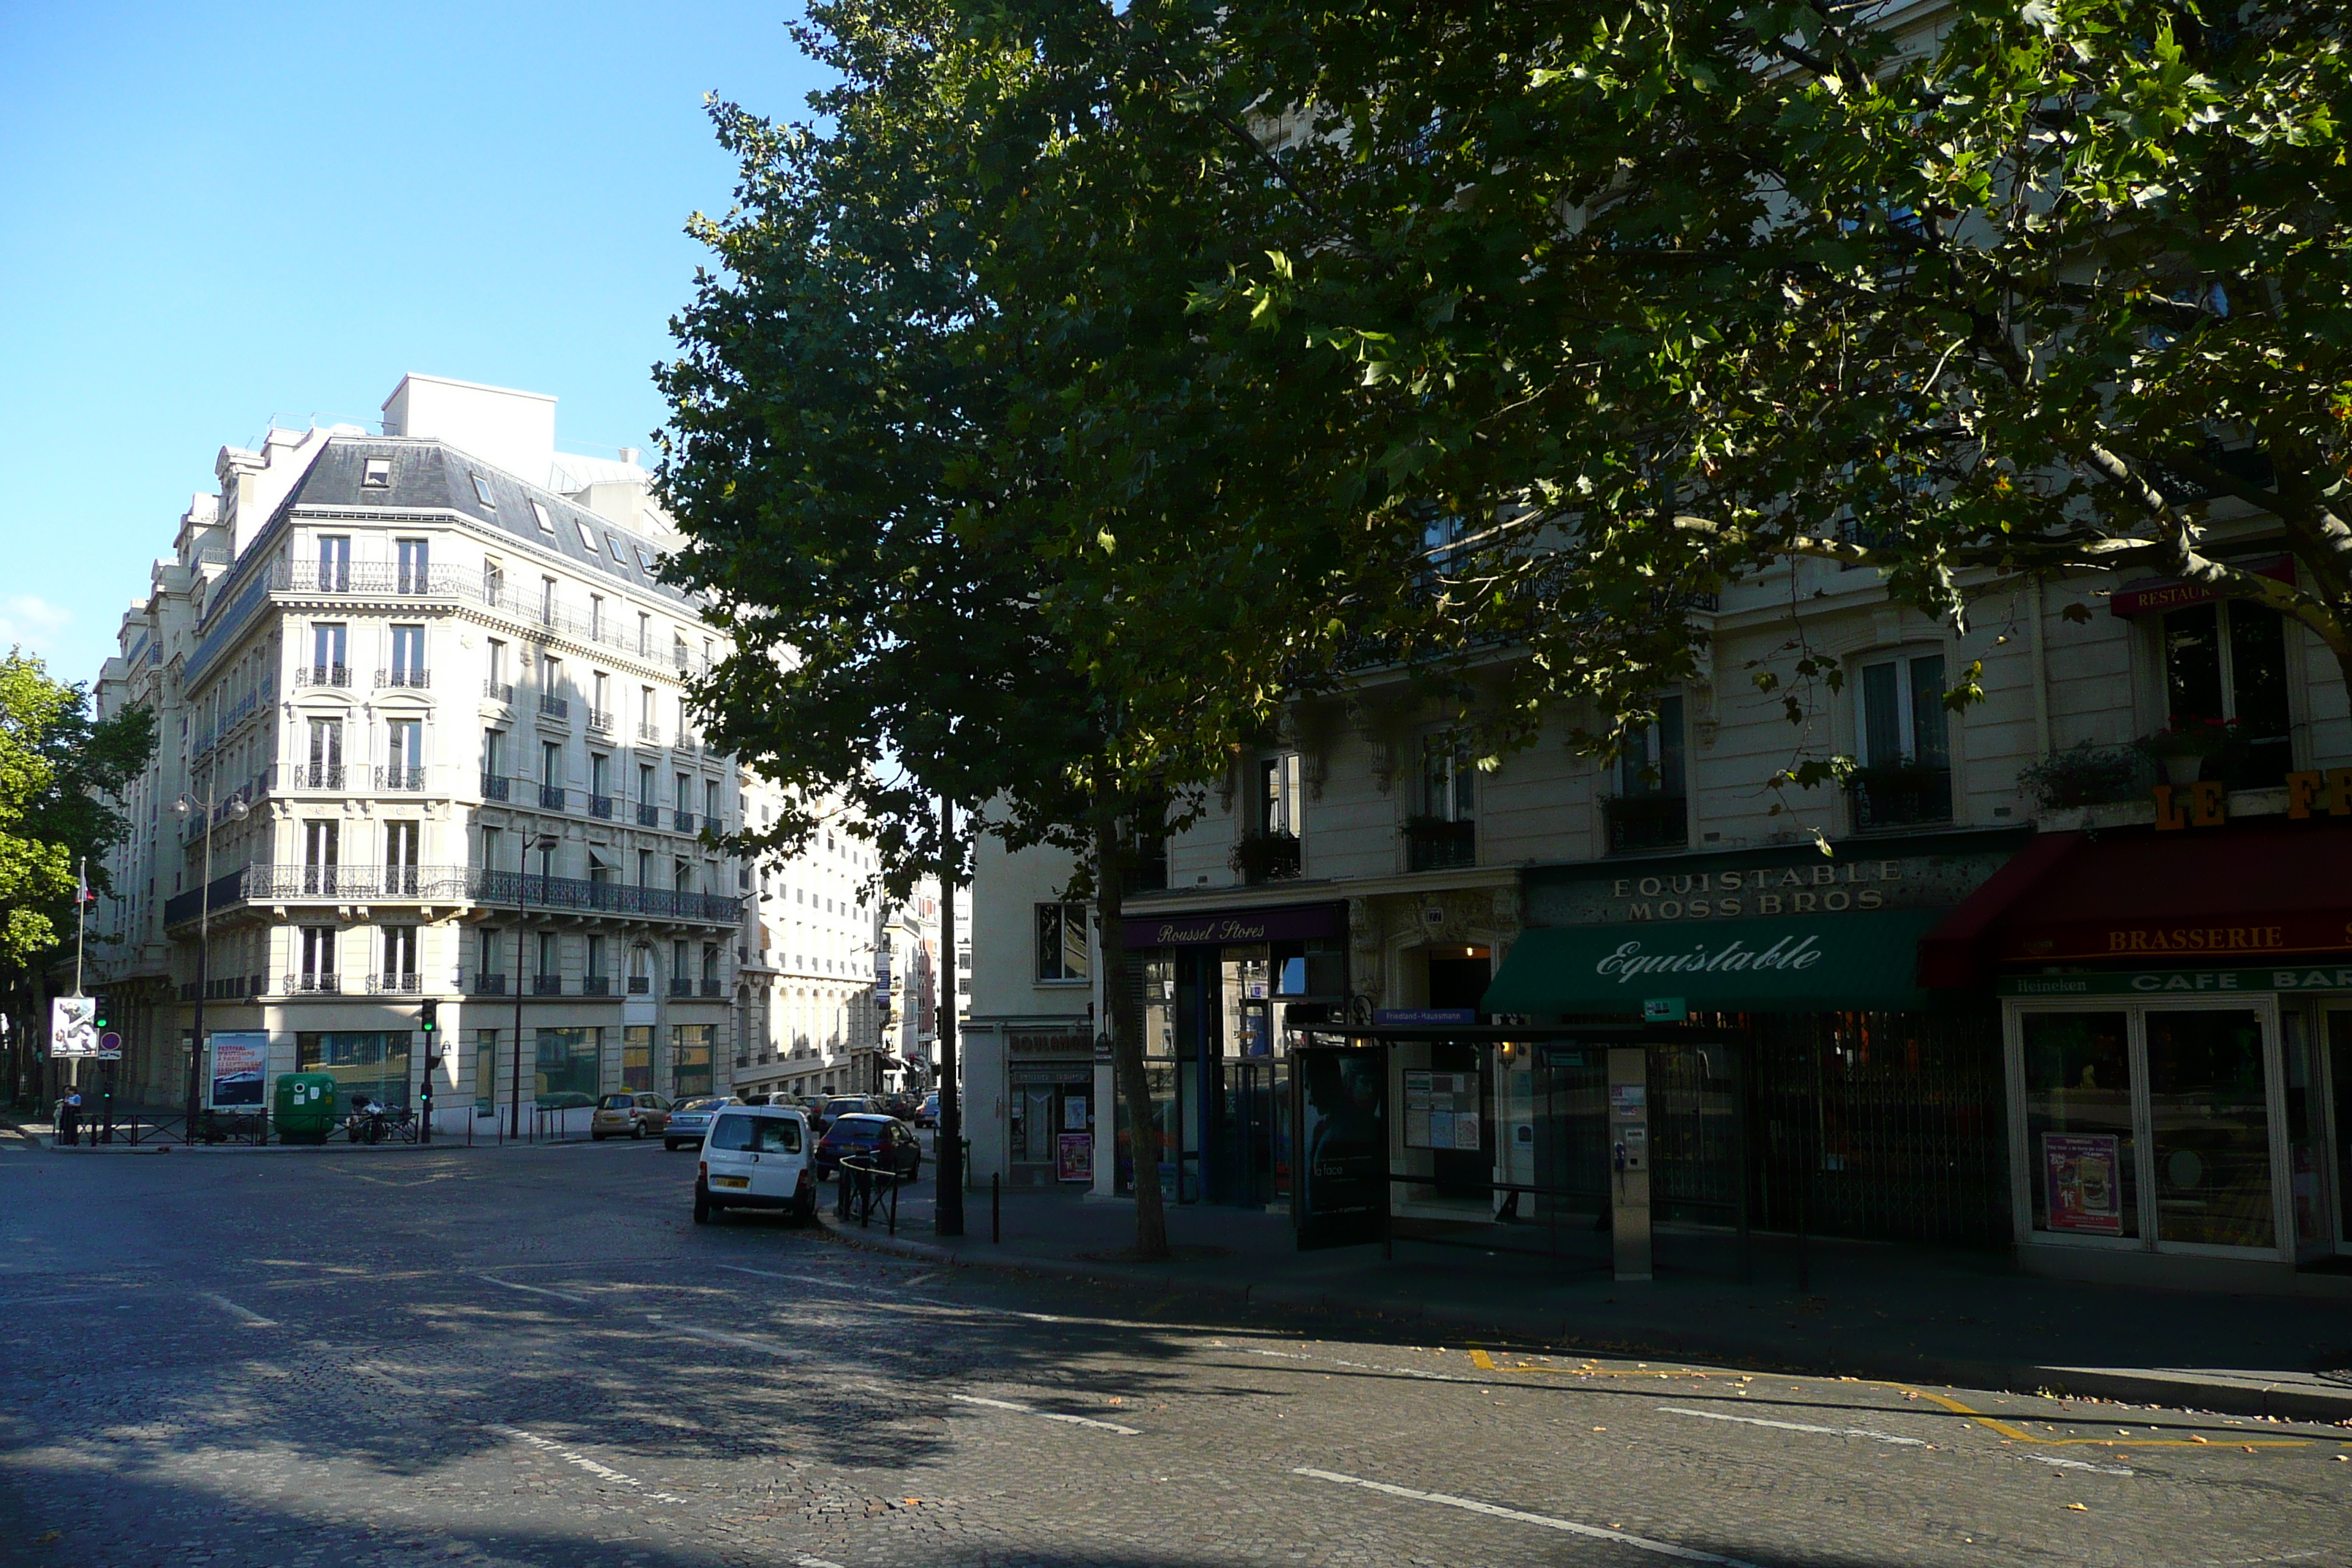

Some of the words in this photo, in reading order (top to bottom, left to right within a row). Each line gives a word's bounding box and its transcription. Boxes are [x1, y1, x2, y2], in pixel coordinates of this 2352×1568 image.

[2138, 587, 2215, 606] RESTAUR
[2152, 780, 2225, 831] LE
[1614, 860, 1902, 897] EQUISTABLE
[1628, 898, 1742, 921] MOSS
[1760, 890, 1883, 914] BROS
[1157, 922, 1215, 943] Roussel
[1219, 920, 1264, 940] Stores
[2108, 927, 2283, 951] BRASSERIE
[1597, 935, 1822, 983] Equistable
[2017, 979, 2087, 992] Heineken
[2131, 973, 2238, 990] CAFE
[1323, 1163, 1343, 1175] face
